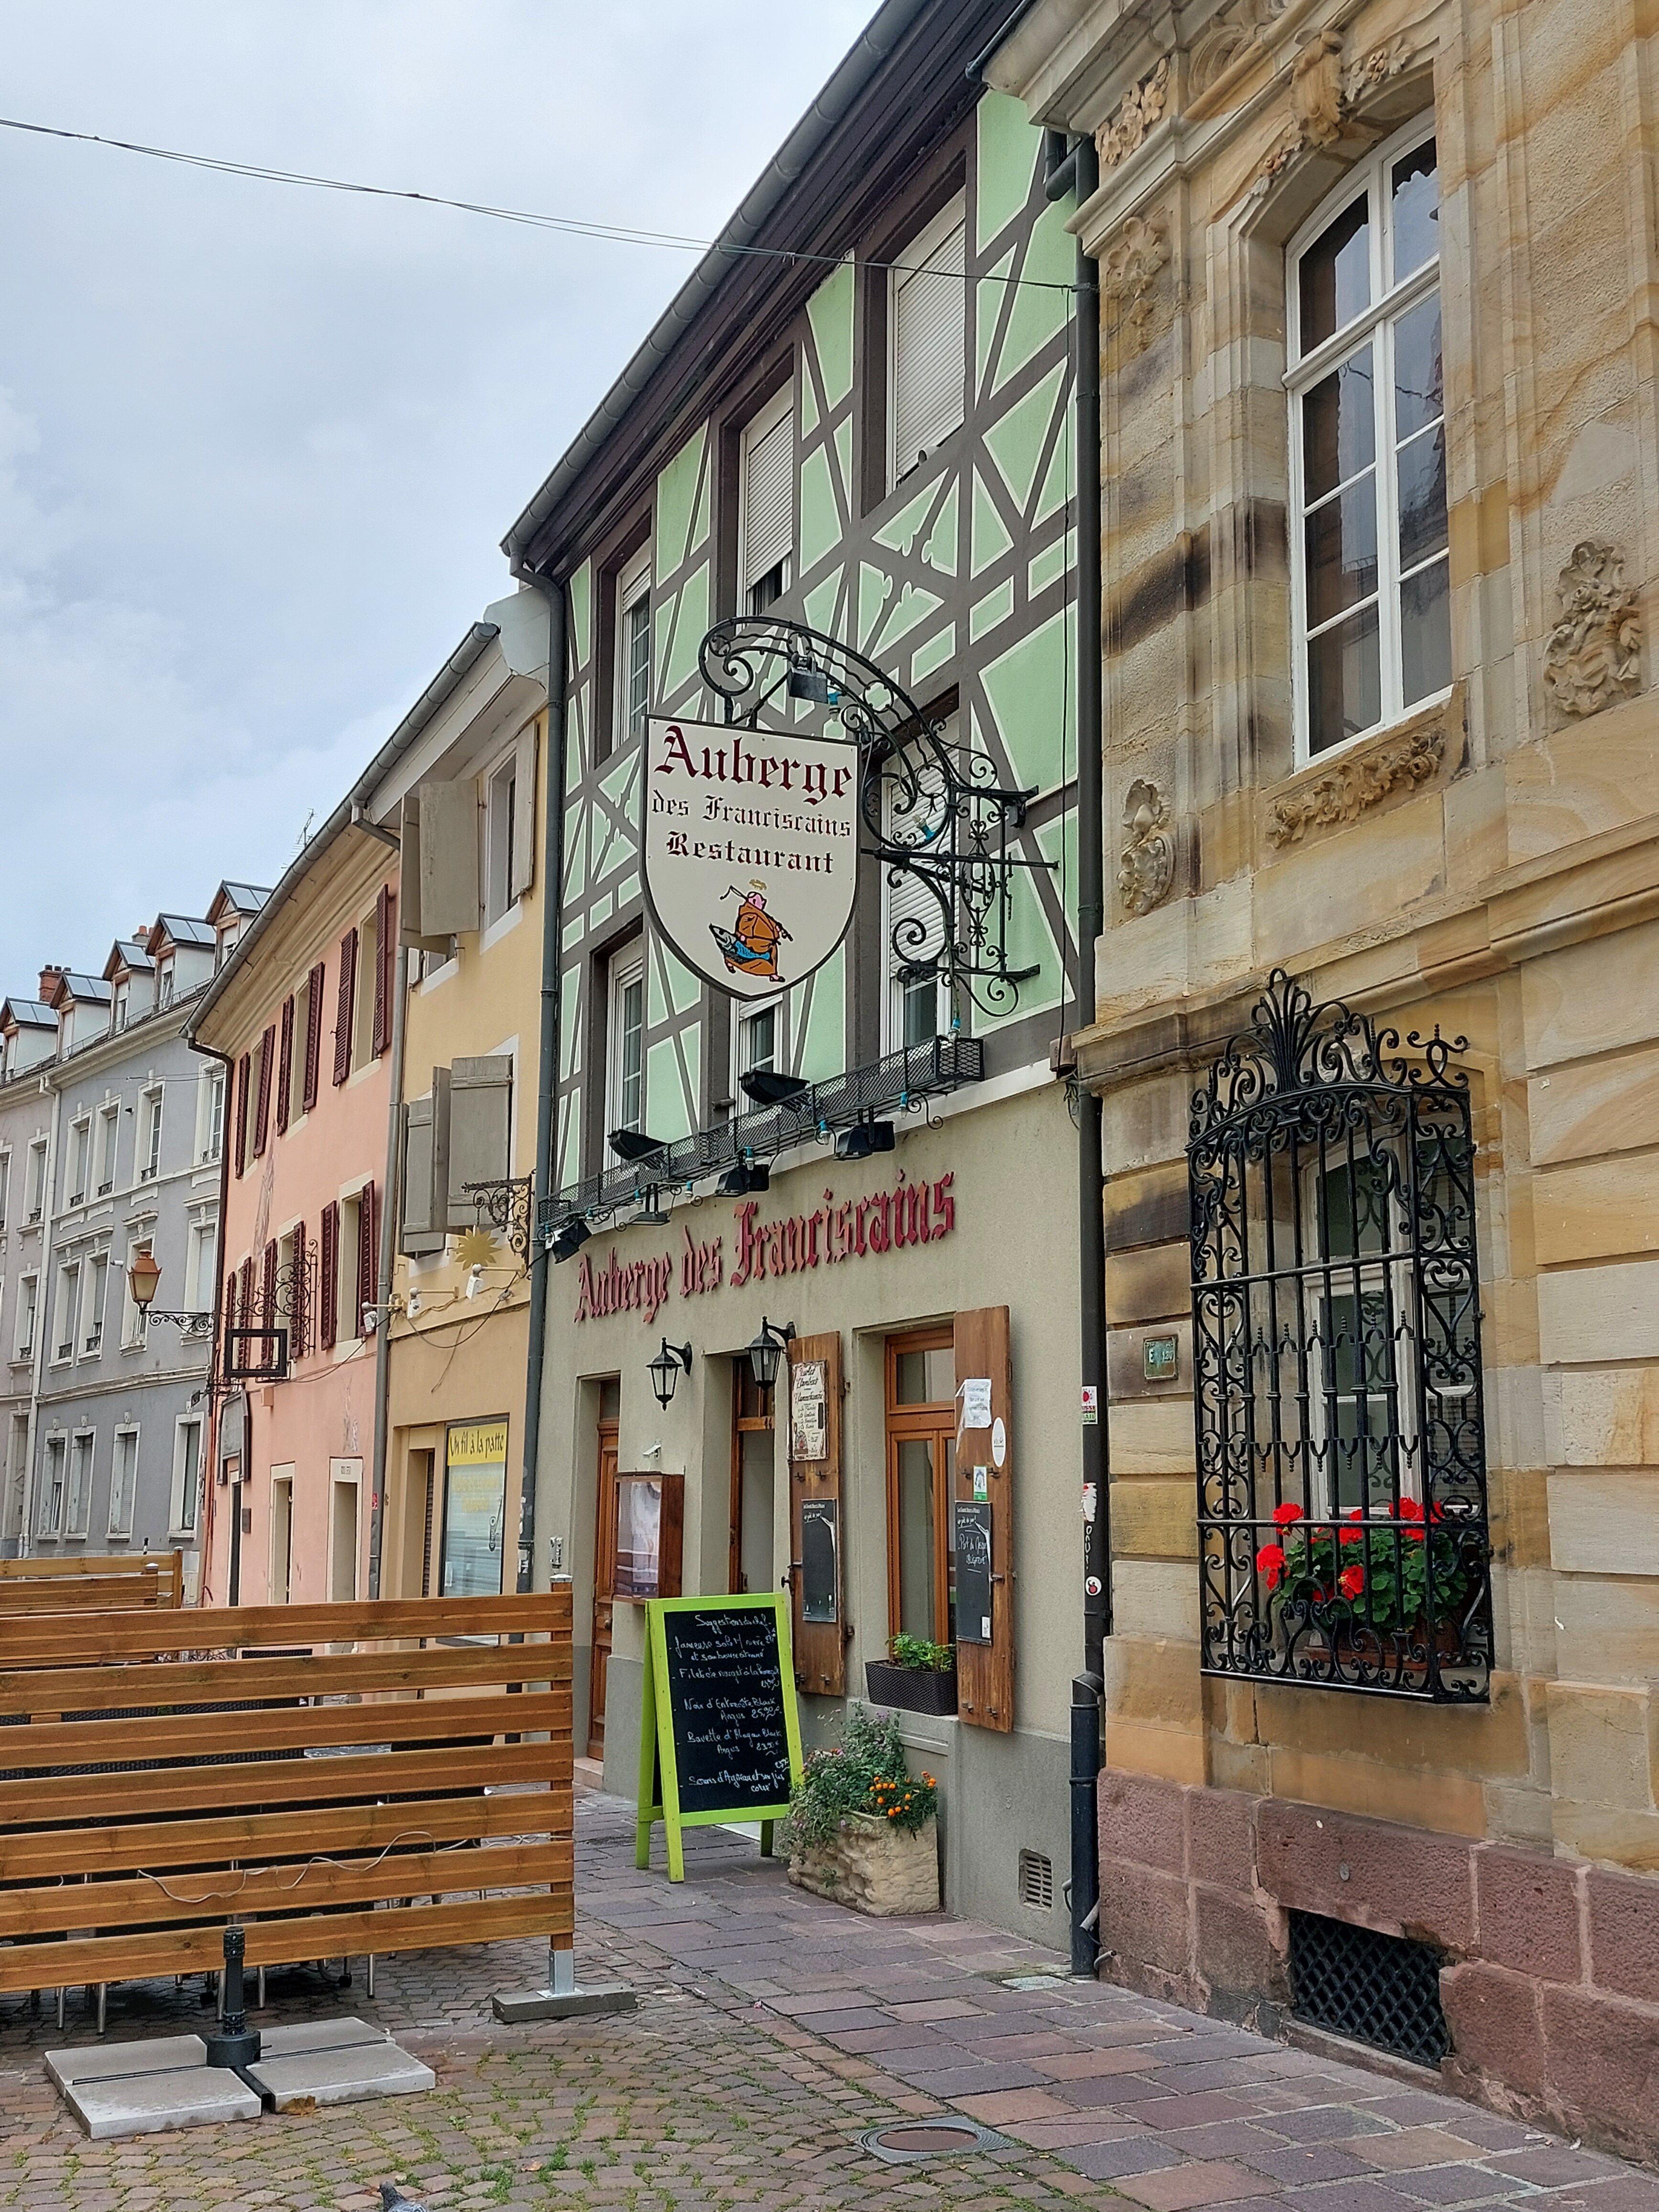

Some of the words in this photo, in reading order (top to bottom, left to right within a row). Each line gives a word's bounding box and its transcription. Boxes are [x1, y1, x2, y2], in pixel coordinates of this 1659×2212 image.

[653, 725, 852, 806] Auberge
[652, 789, 690, 816] des
[702, 794, 851, 837] Franciscains
[665, 831, 834, 874] Restaurant
[574, 1246, 671, 1324] Auberge
[680, 1225, 723, 1298] des
[730, 1169, 955, 1287] Franciscains
[450, 1435, 459, 1457] Un
[470, 1434, 475, 1455] à
[477, 1429, 484, 1453] la
[486, 1432, 504, 1459] patte
[695, 1615, 743, 1634] Suggestions
[720, 1710, 746, 1726] Angus
[687, 1727, 720, 1743] Bavette
[762, 1728, 782, 1737] Black
[717, 1744, 740, 1760] Angus
